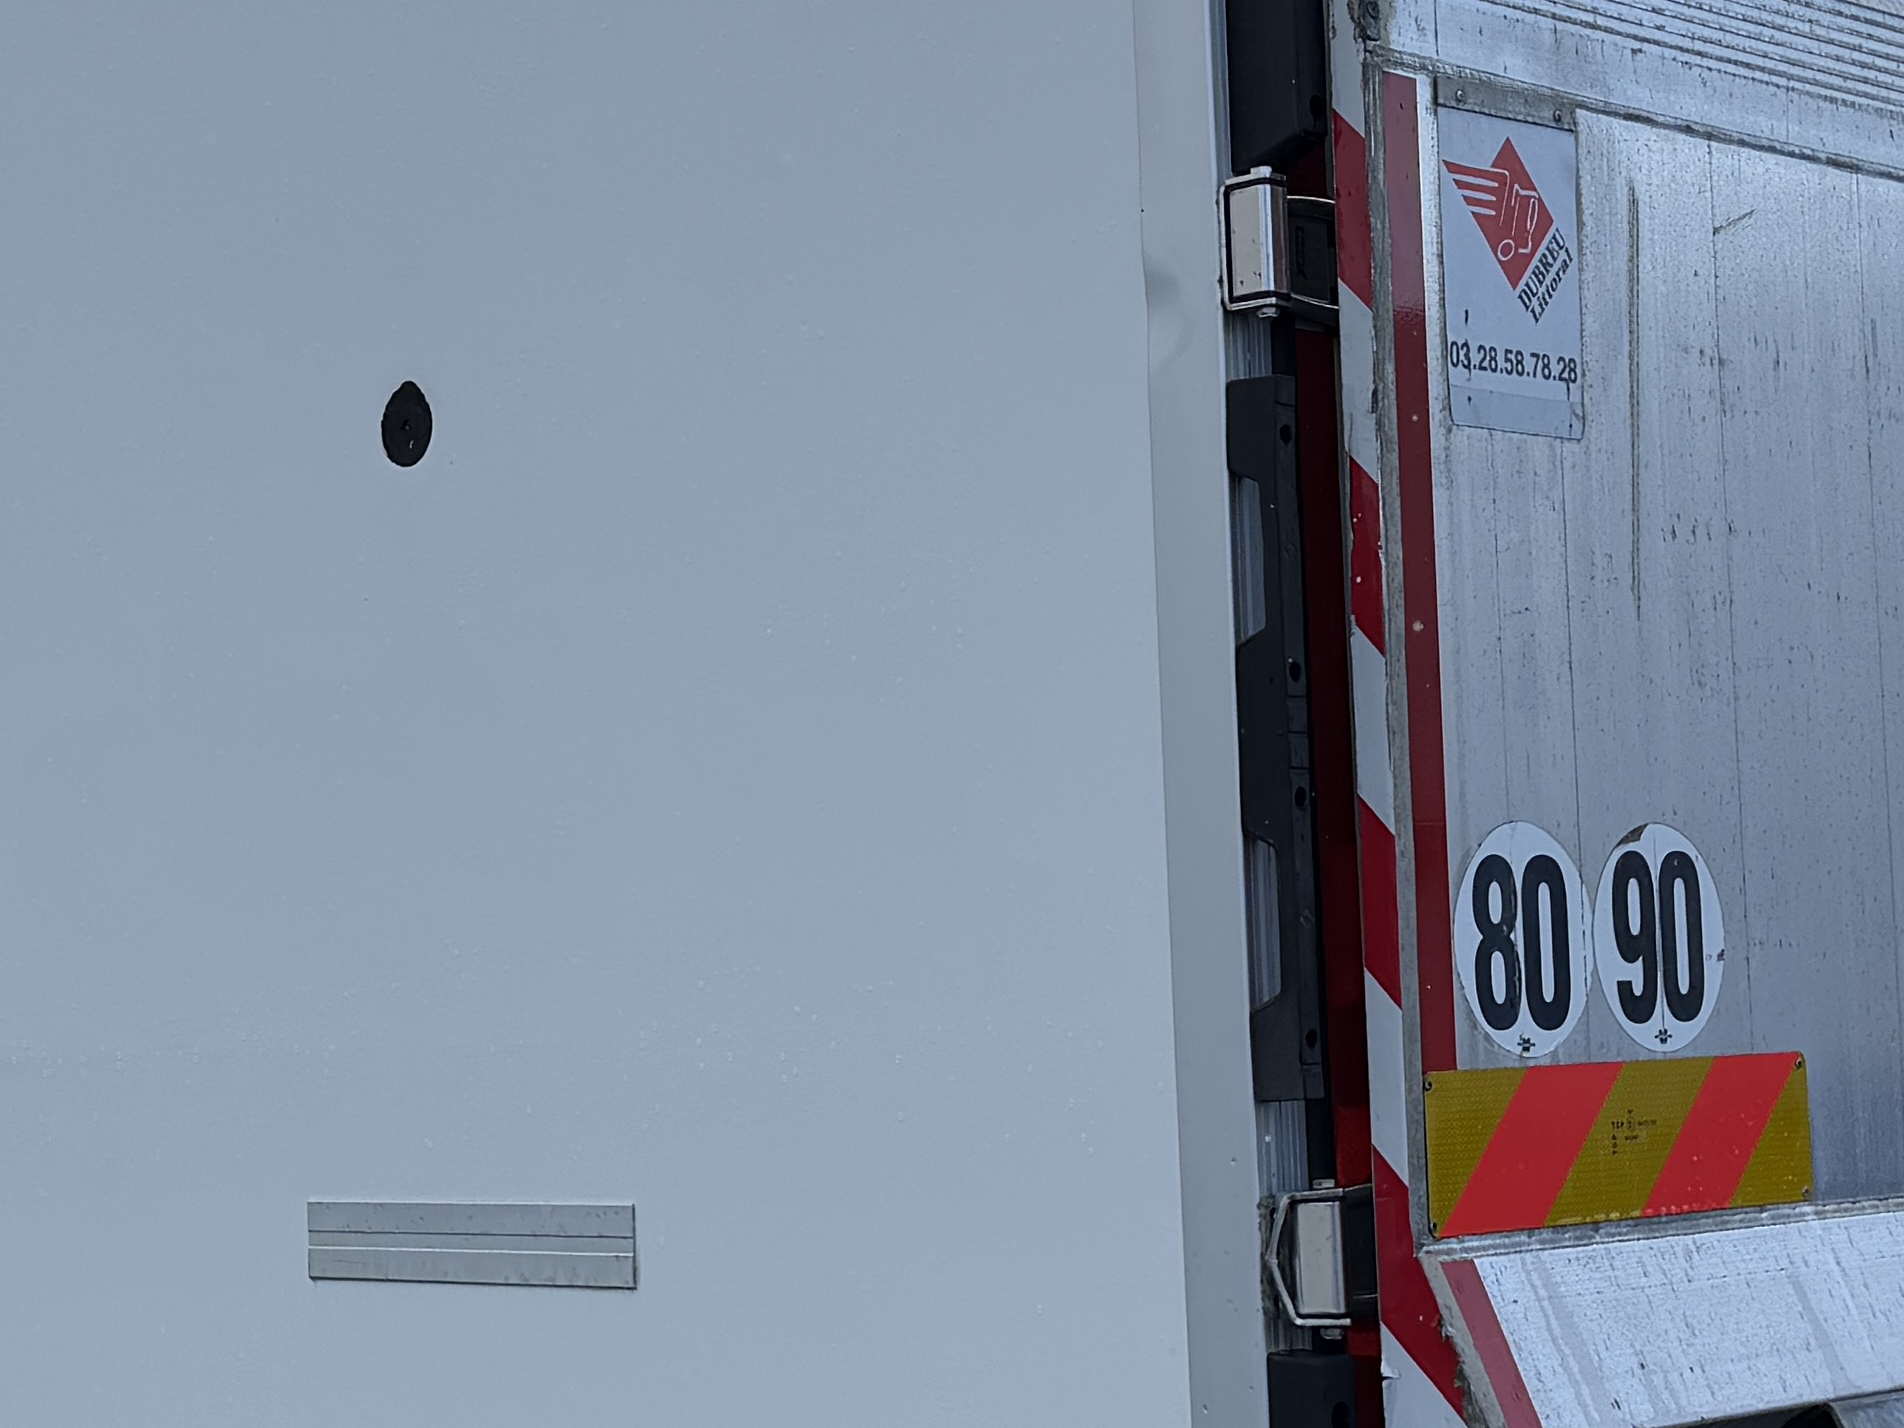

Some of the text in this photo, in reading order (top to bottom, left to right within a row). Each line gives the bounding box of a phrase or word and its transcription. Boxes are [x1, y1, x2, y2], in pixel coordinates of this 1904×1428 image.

[1517, 227, 1566, 312] DUBREU
[1529, 248, 1574, 324] Littoral
[1449, 340, 1578, 384] 03.28.58.78.28
[1472, 853, 1571, 1032] 80
[1611, 850, 1705, 1025] 90
